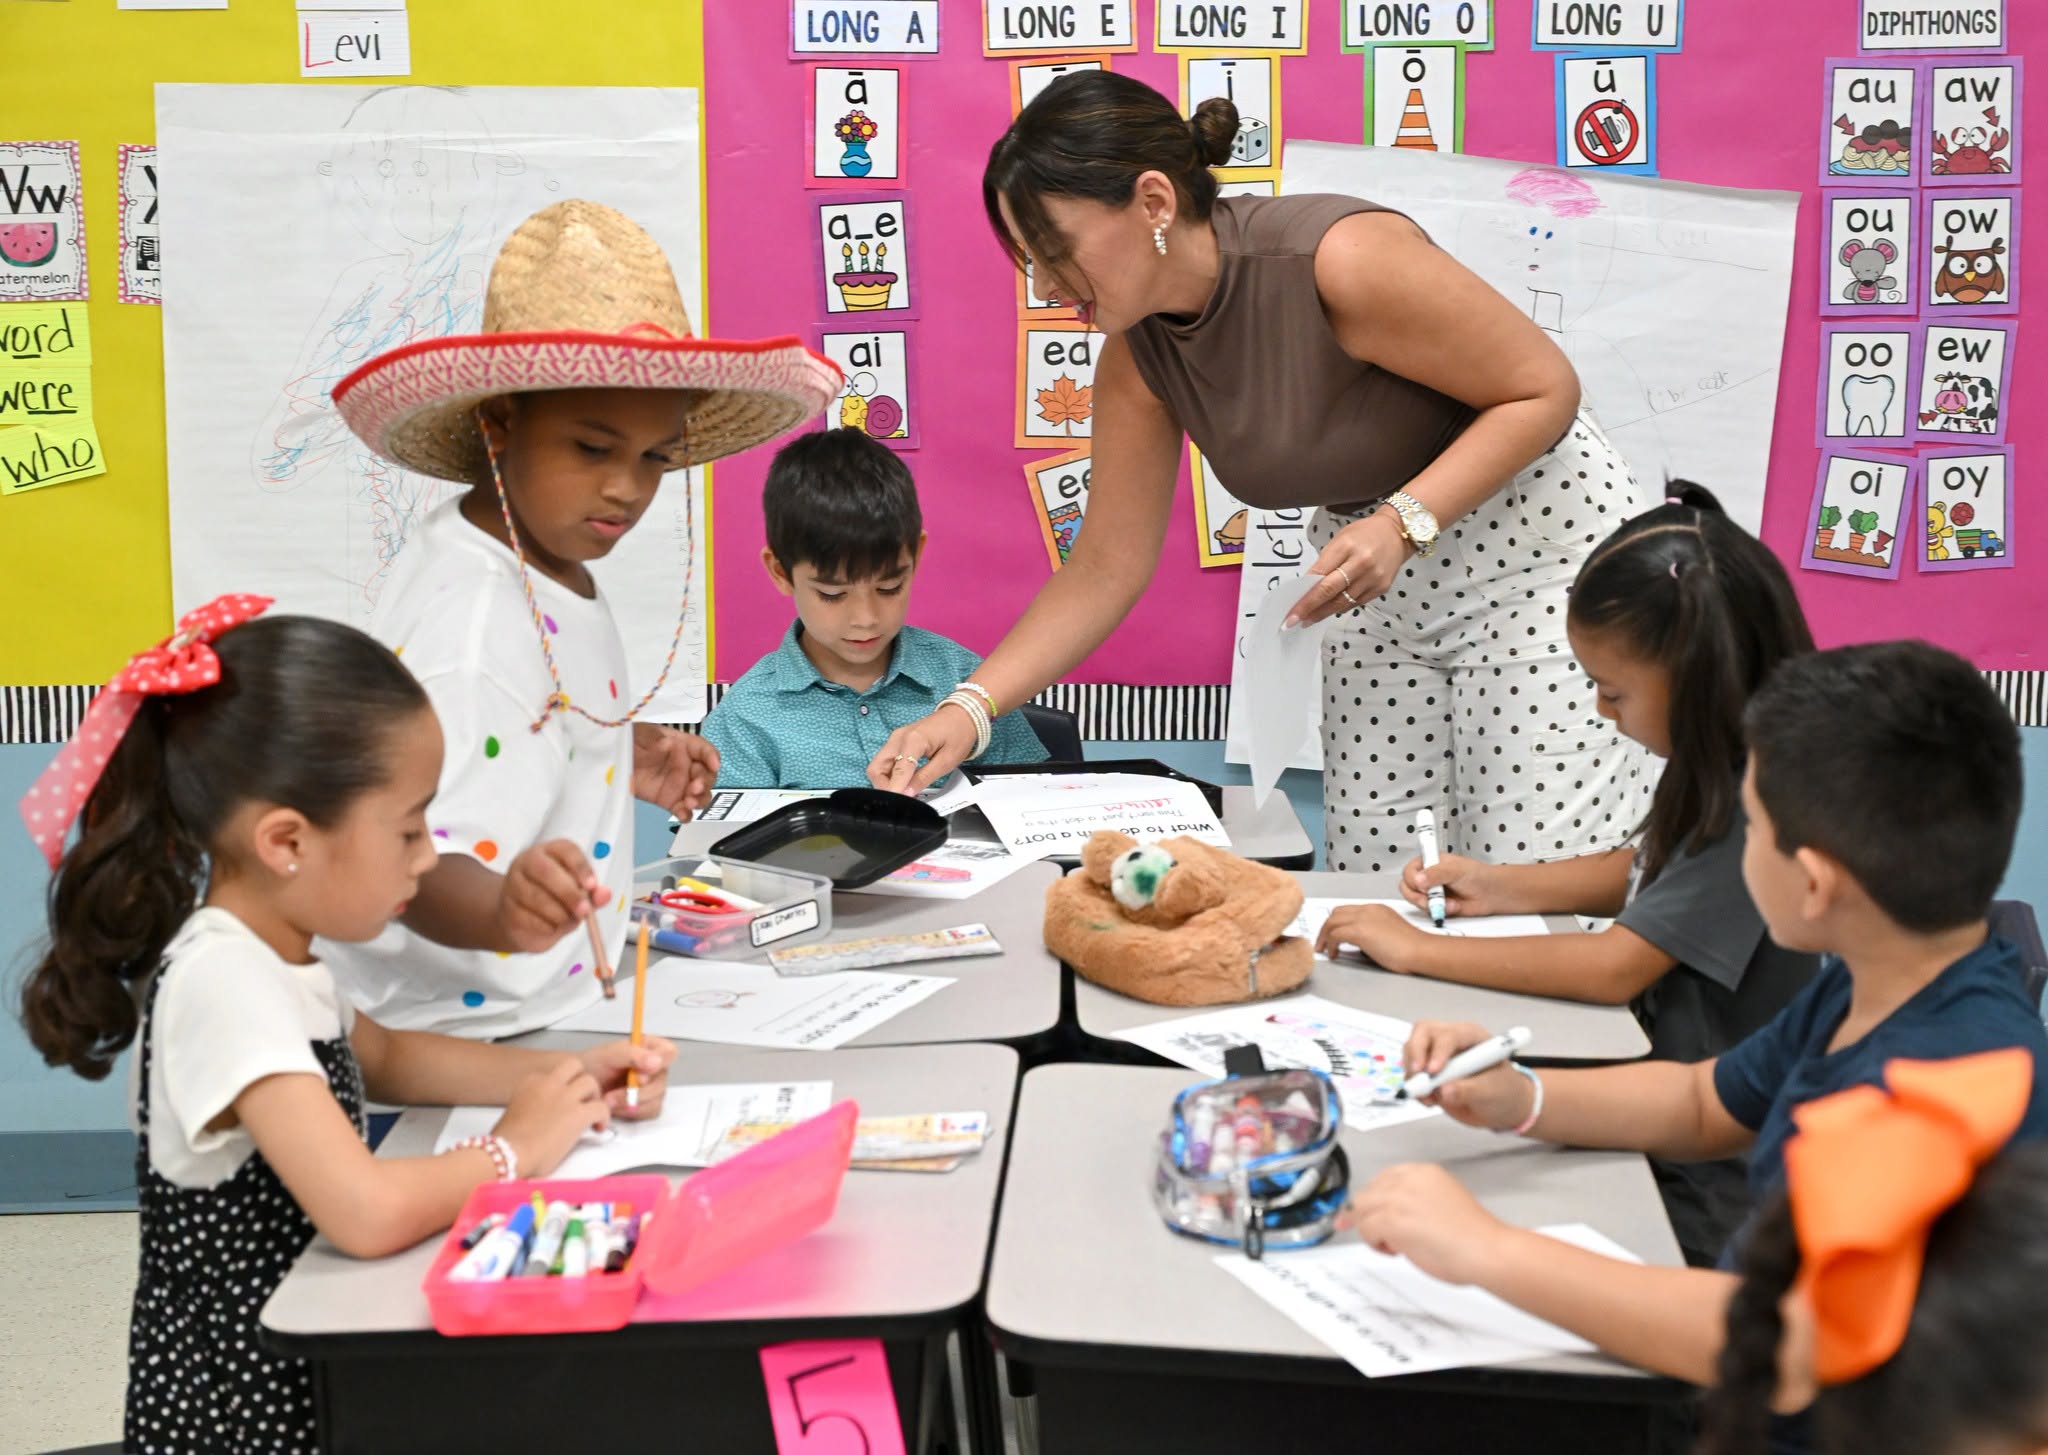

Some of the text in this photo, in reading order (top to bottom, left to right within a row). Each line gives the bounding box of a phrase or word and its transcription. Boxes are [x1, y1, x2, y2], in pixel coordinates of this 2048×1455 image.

[808, 10, 924, 44] LONG A
[1003, 4, 1115, 40] LONG E
[1175, 5, 1286, 39] LONG I
[1359, 2, 1475, 37] LONG O
[1551, 2, 1664, 37] LONG U
[1867, 9, 1998, 38] DIPHTHONGS
[304, 20, 381, 69] Levi
[1848, 77, 1897, 104] au
[1944, 76, 2001, 104] aw
[1846, 207, 1894, 233] ou
[1943, 208, 2000, 235] ow
[0, 272, 70, 285] atermelon
[849, 336, 882, 367] ai
[1043, 340, 1091, 367] ea
[1844, 342, 1893, 368] oo
[1937, 337, 1992, 364] ew
[0, 381, 78, 413] were
[1, 432, 94, 483] who
[1850, 466, 1883, 498] oi
[1943, 465, 1989, 496] oy
[1156, 809, 1185, 817] This
[1014, 832, 1056, 846] DOT?
[1060, 831, 1072, 839] a
[1119, 827, 1140, 836] do
[1146, 825, 1164, 834] to
[1171, 822, 1215, 833] What
[786, 1355, 871, 1455] 5
